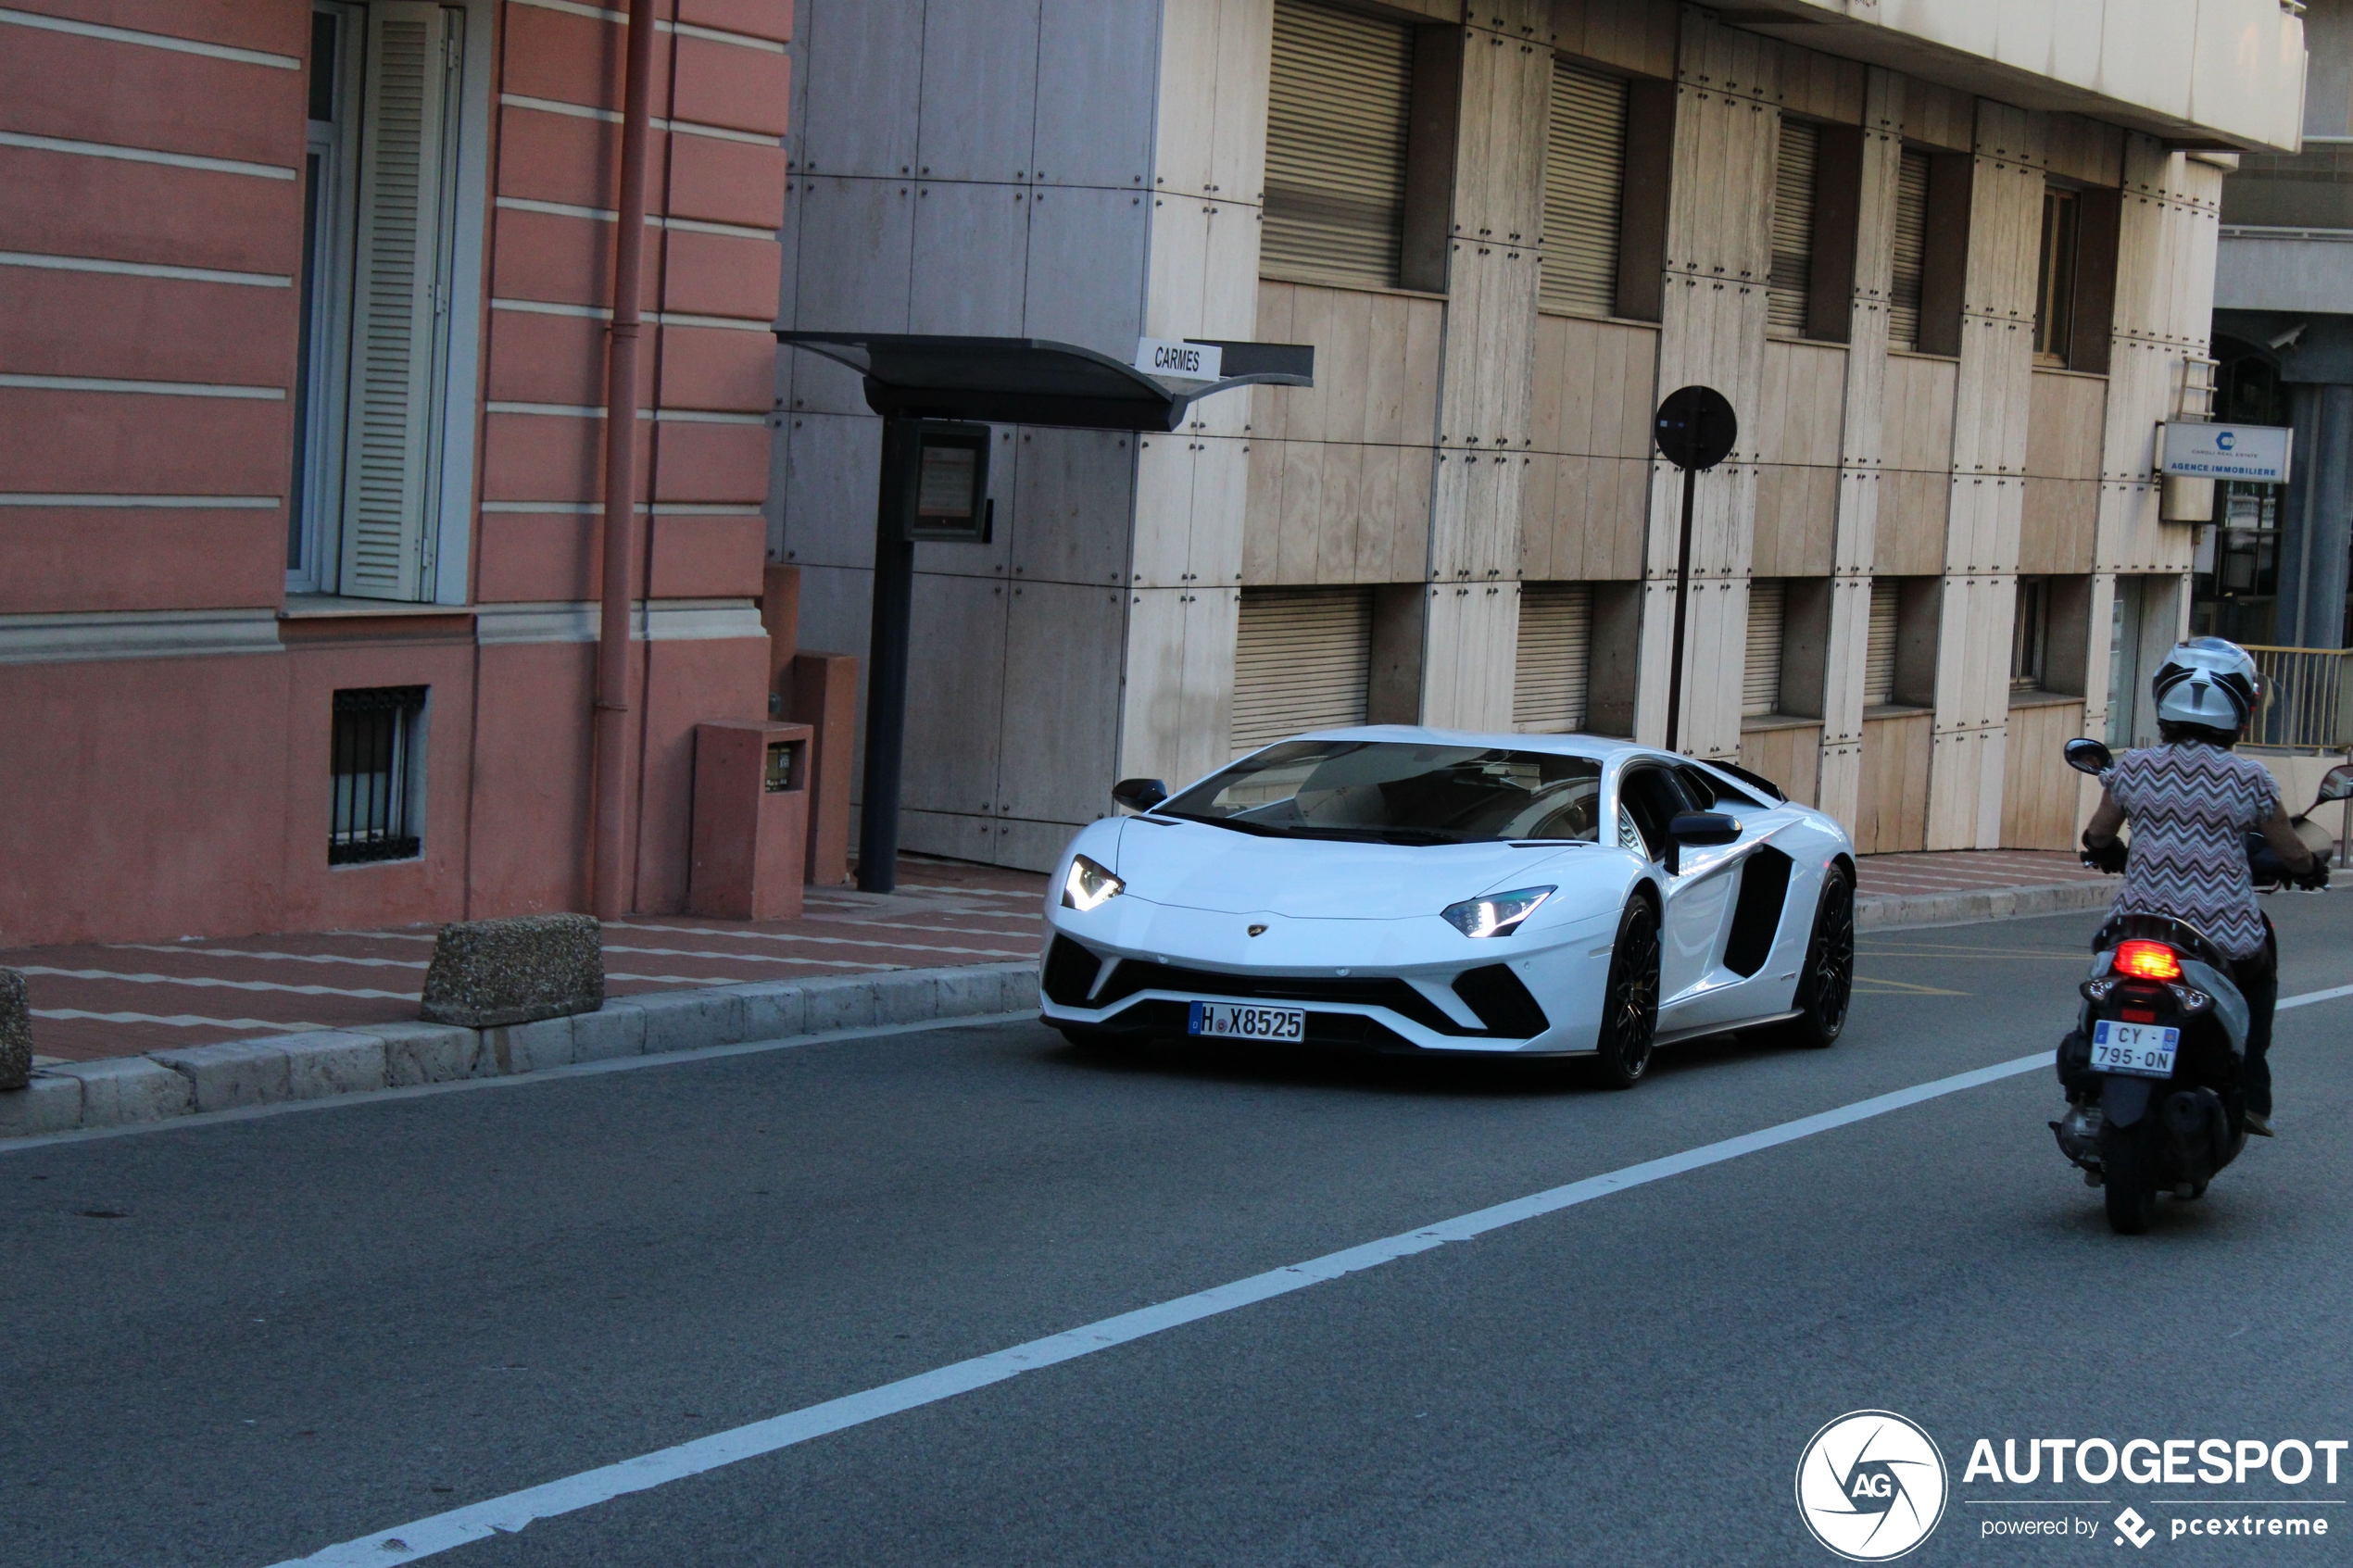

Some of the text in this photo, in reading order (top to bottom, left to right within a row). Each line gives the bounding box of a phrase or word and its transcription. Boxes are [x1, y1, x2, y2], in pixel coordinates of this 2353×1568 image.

[1154, 345, 1200, 372] CARMES
[2171, 462, 2276, 476] AGENCE IMMOBILIERE
[1192, 1021, 1198, 1029] D
[1201, 1006, 1302, 1037] H X8525
